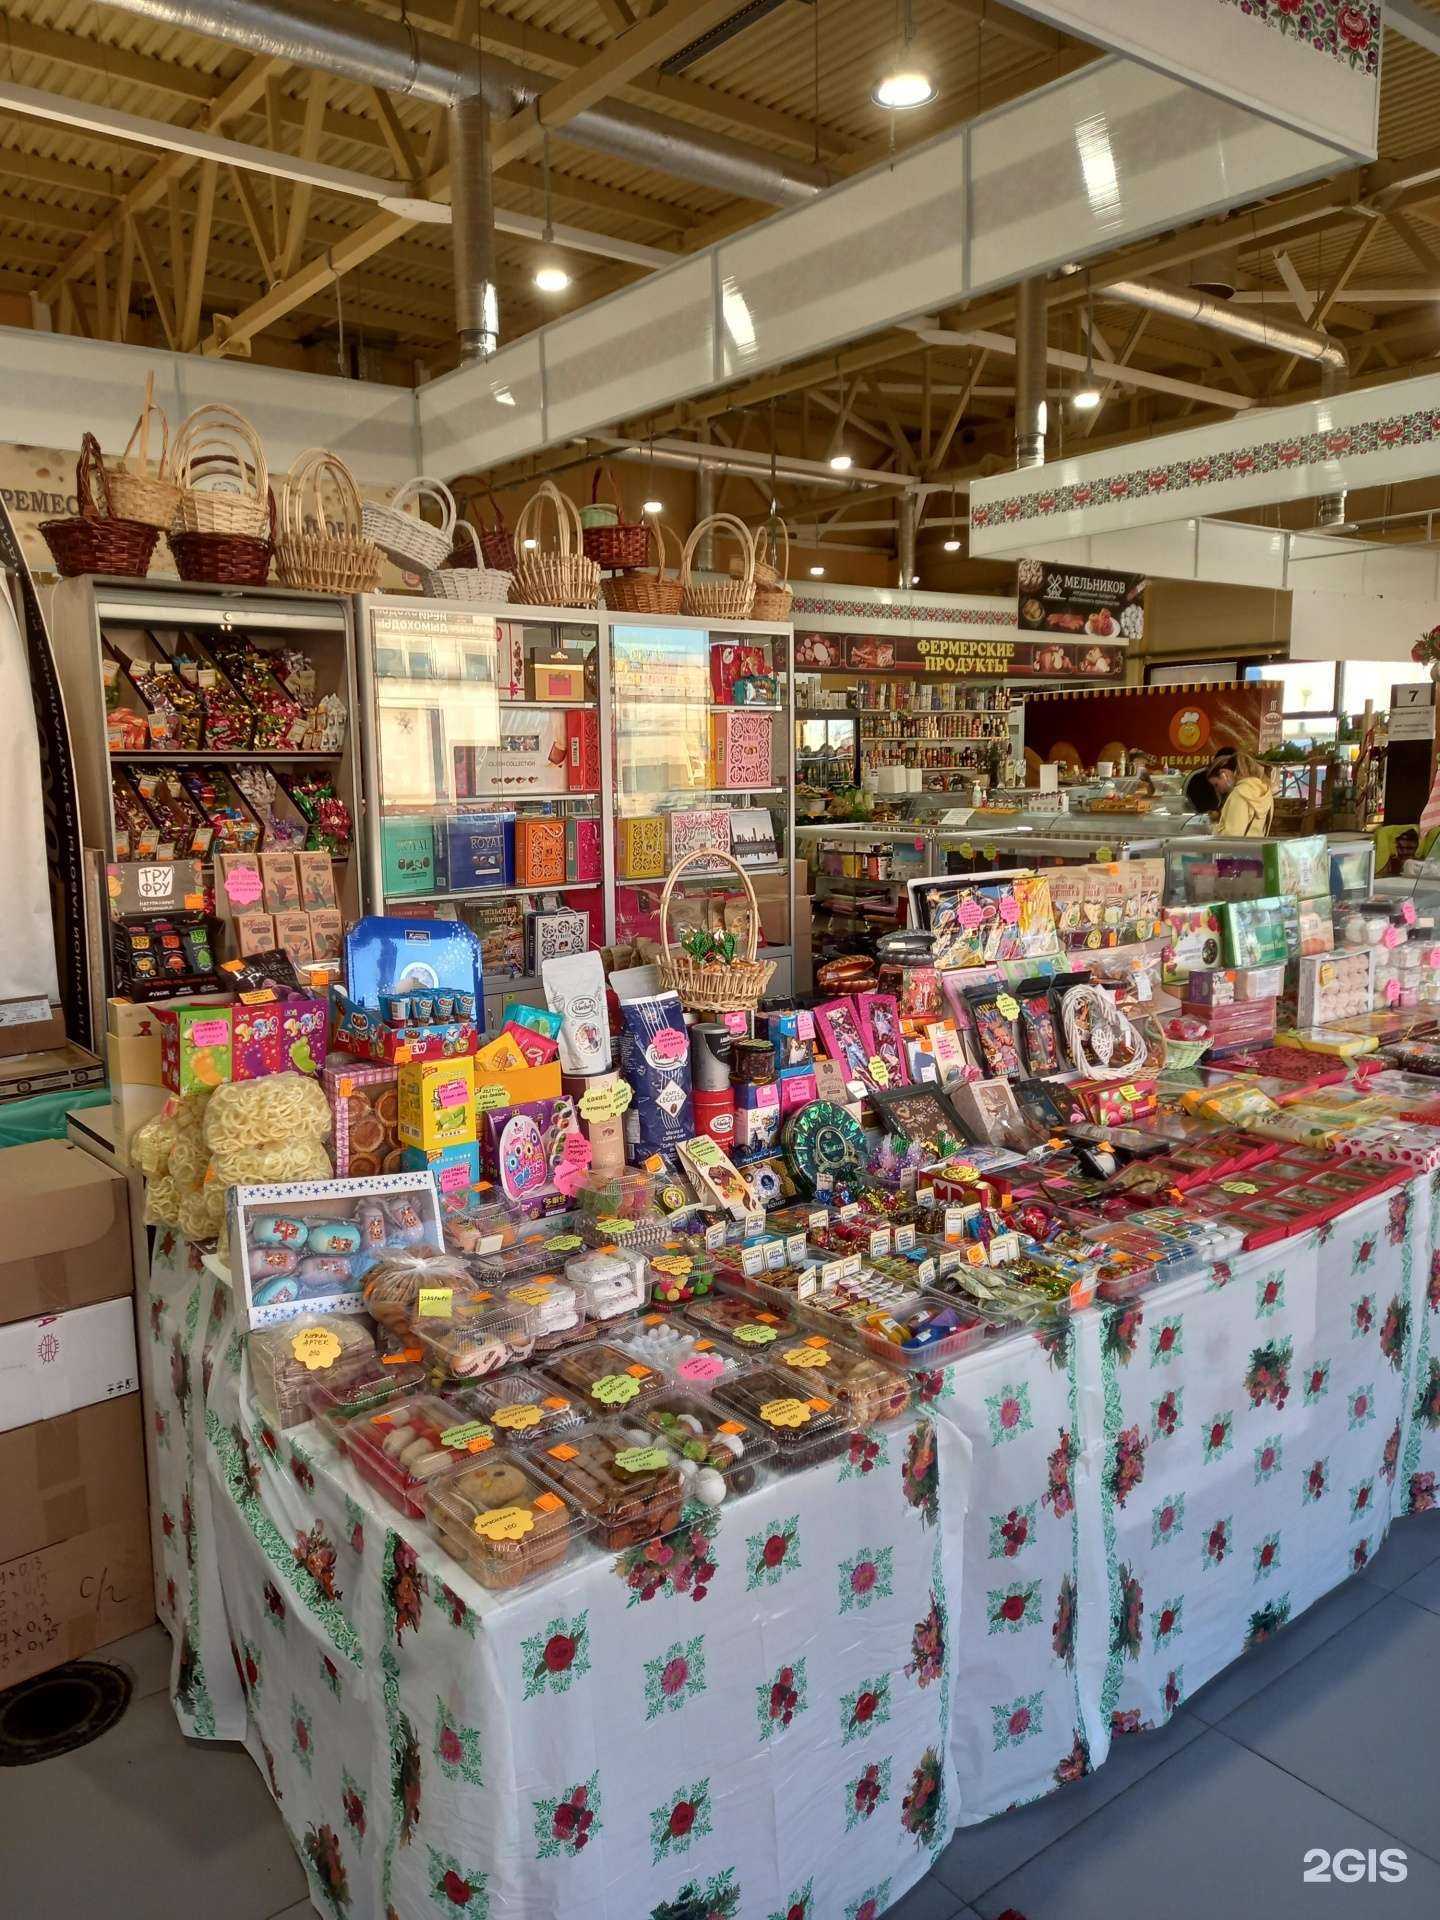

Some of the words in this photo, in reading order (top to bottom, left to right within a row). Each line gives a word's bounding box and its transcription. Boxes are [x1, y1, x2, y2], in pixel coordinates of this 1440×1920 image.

[1064, 575, 1126, 594] МЕЛЬНИКОВ
[917, 639, 1015, 657] ФЕРМЕРСКИЕ
[924, 656, 1008, 674] ПРОДУКТЫ
[1408, 689, 1420, 702] 7
[140, 868, 171, 882] ТРУ
[141, 882, 171, 896] ФРУ
